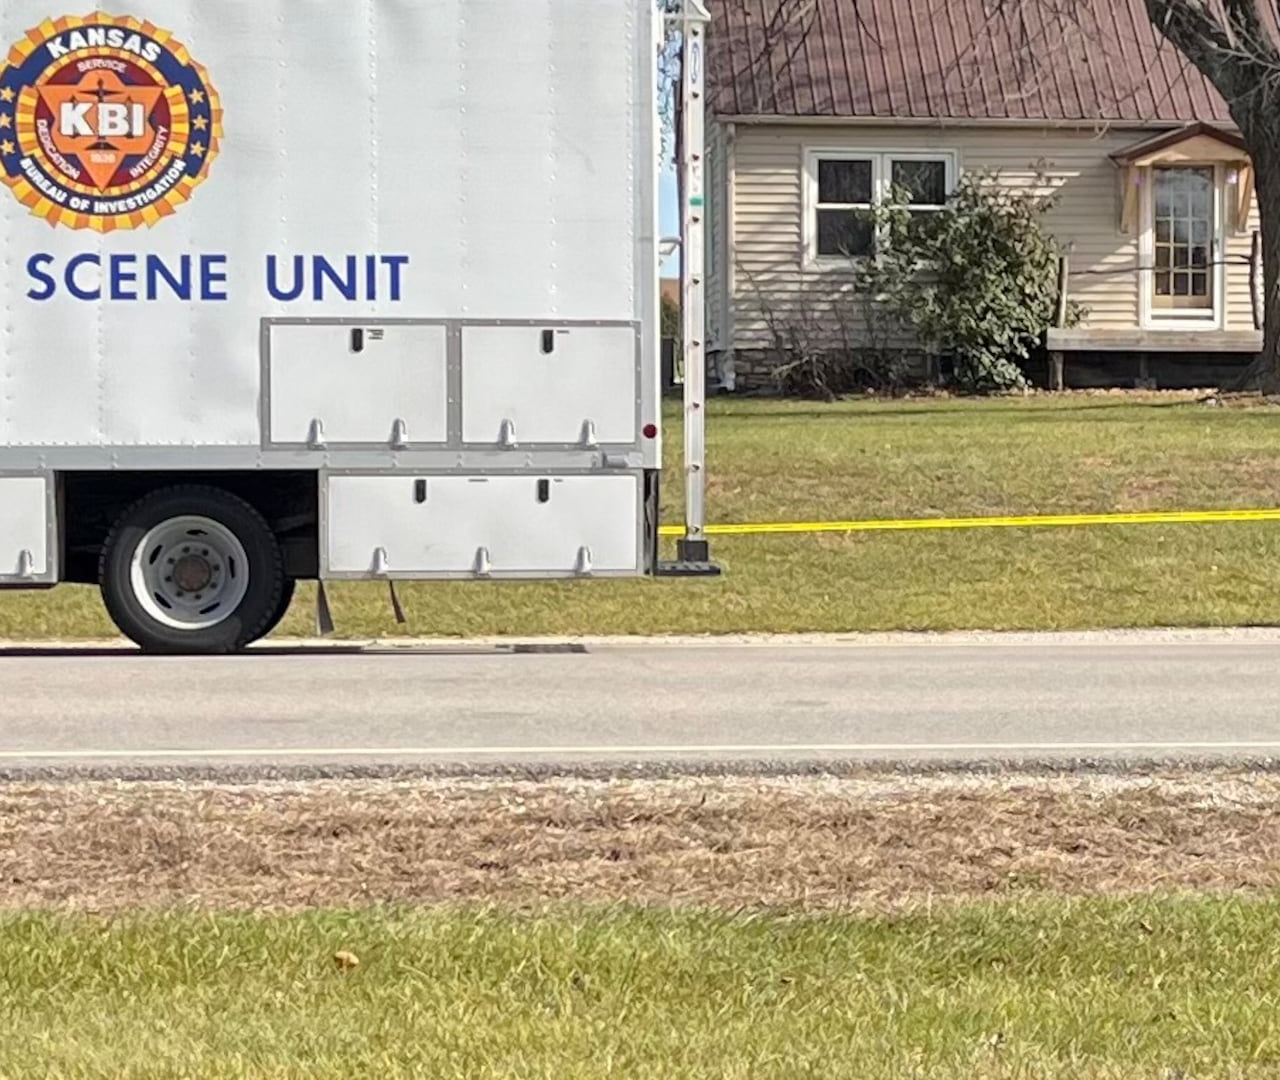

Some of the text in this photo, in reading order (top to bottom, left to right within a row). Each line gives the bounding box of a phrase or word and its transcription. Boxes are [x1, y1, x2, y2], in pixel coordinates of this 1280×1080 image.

[46, 28, 161, 61] KANSAS
[76, 58, 128, 73] SERVICE
[60, 102, 144, 137] KBI
[36, 119, 81, 180] DEDICATION
[129, 124, 169, 178] INTEGRITY
[20, 158, 187, 214] BUREAU OF INVESTIGATION
[26, 252, 228, 301] SCENE
[266, 254, 410, 302] UNIT
